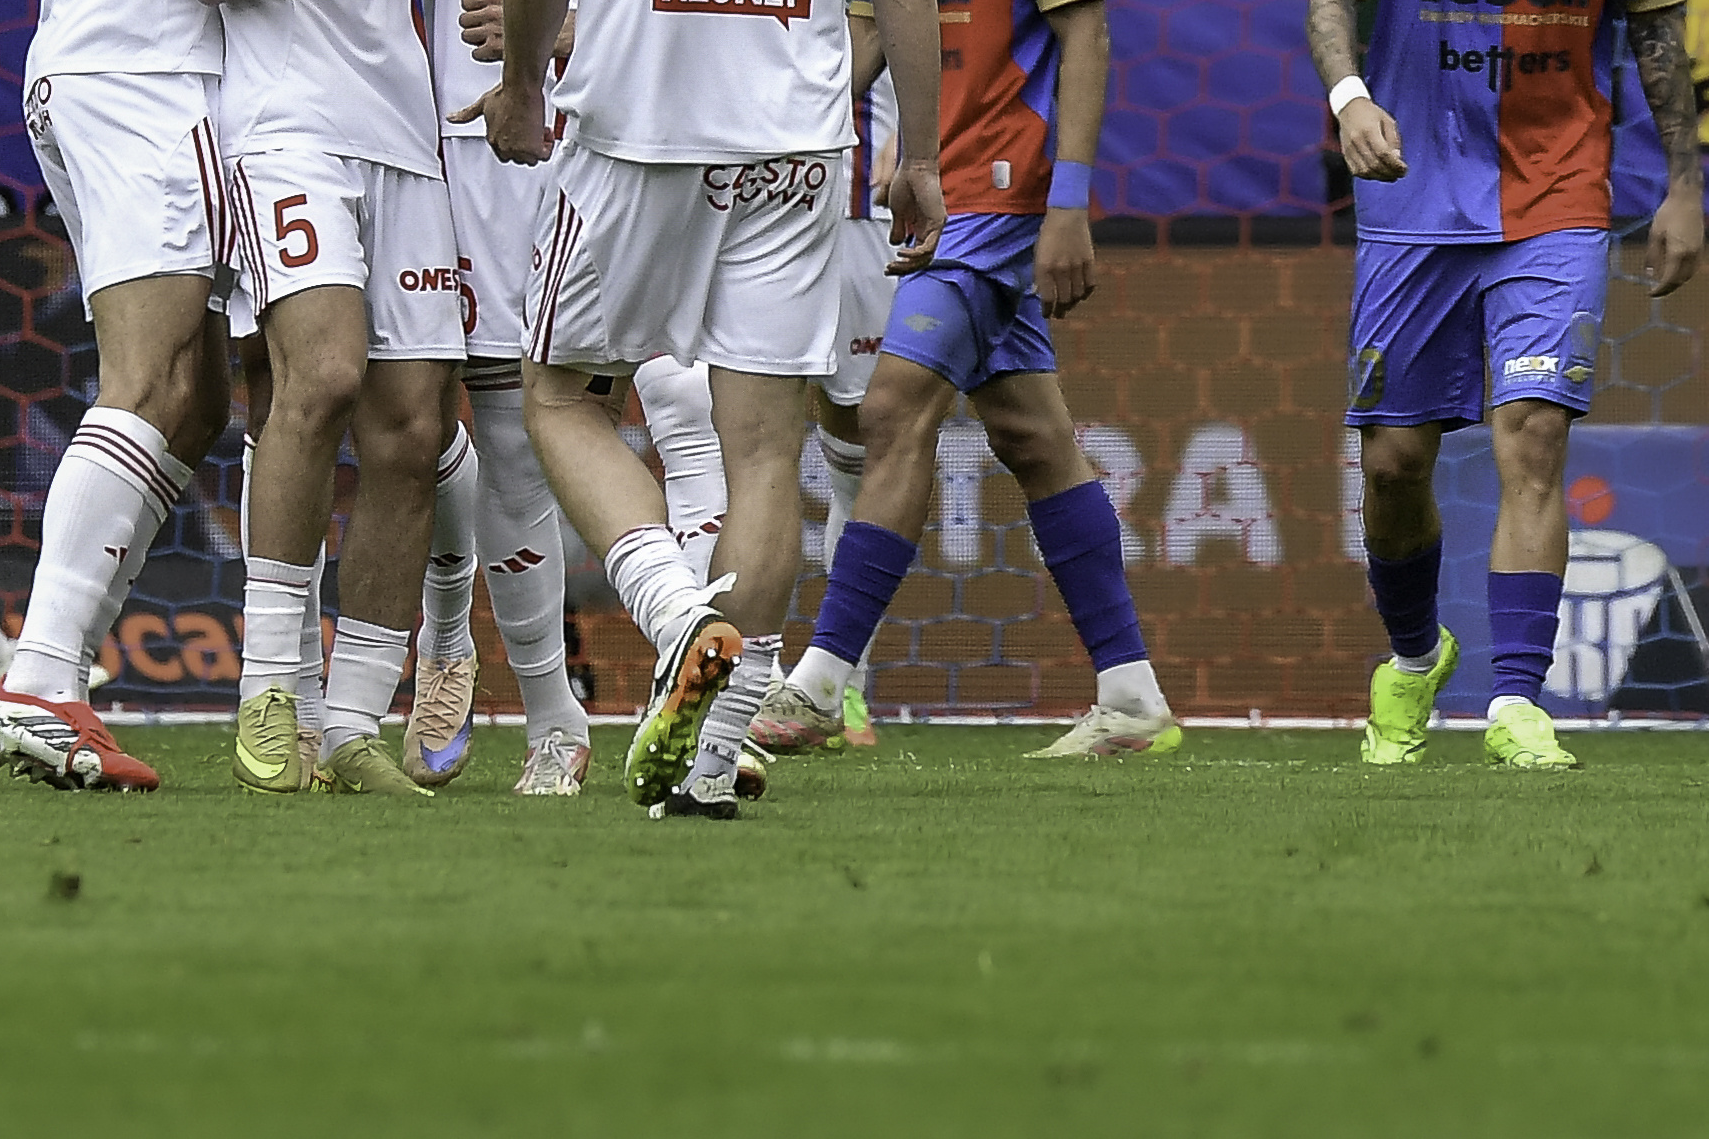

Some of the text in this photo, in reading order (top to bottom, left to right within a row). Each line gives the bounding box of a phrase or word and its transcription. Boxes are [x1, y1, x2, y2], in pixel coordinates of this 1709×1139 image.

[1440, 40, 1571, 93] betters
[274, 194, 318, 268] 5
[399, 268, 459, 292] ONES
